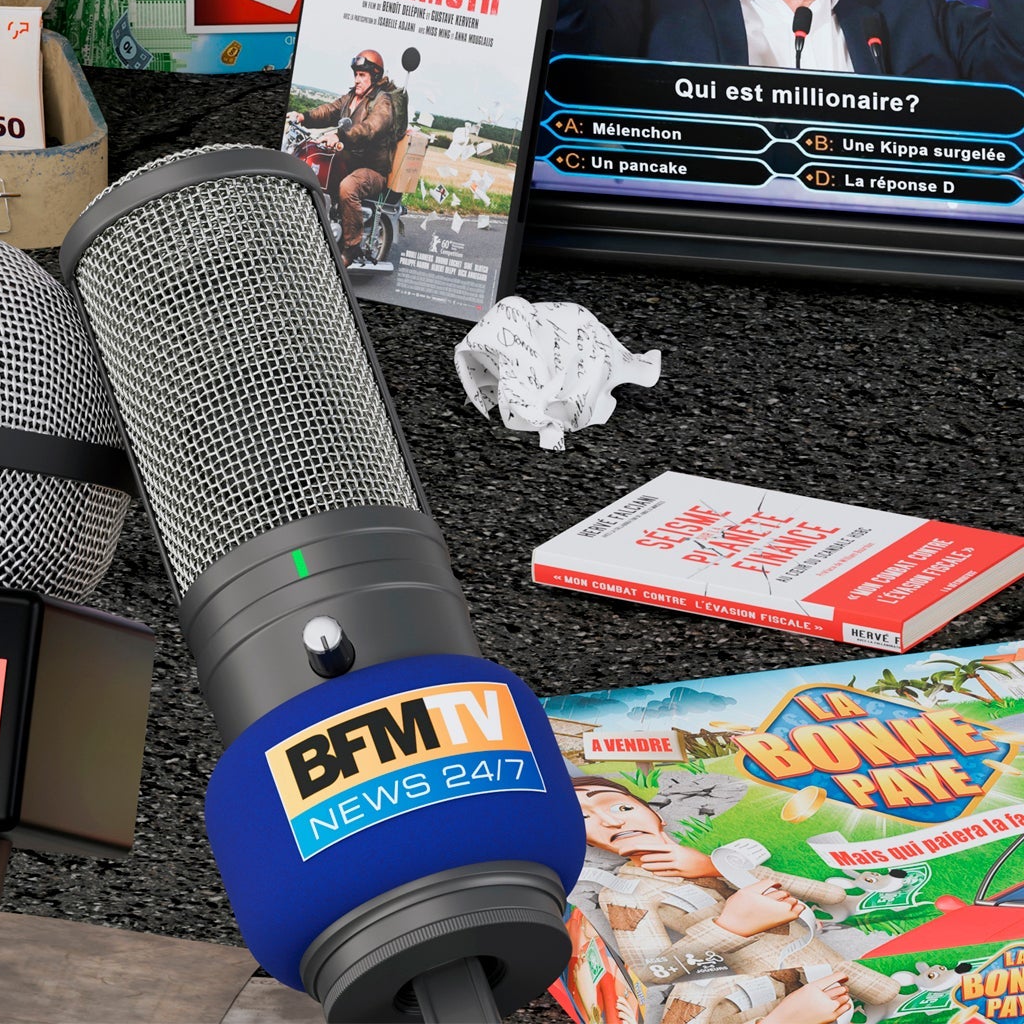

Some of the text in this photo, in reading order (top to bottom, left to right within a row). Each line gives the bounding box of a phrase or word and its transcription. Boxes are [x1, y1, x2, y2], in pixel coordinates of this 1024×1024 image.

[431, 11, 454, 25] GUSTAVE
[455, 15, 479, 29] KERVERN
[675, 78, 920, 113] Qui est millionaire?
[564, 118, 682, 141] A: Mélenchon
[565, 154, 687, 177] C: Un pancake
[815, 136, 1006, 164] B: Une Kippa surgelée
[815, 171, 955, 195] D: La réponse D
[577, 518, 617, 539] HERVÉ
[613, 494, 660, 521] FALCIANI
[635, 505, 732, 550] SÉISME
[732, 521, 841, 574] FINANCE
[871, 560, 918, 584] COMBAT
[908, 537, 954, 561] CONTRE
[564, 576, 811, 631] MON COMBAT CONTRE L'ÉVASION FISCALE
[851, 627, 890, 643] HERVÉ
[793, 690, 869, 722] LA
[286, 690, 504, 801] BFMTV
[592, 736, 673, 753] A VENDRE
[731, 708, 1000, 780] BONNE
[309, 758, 525, 841] NEWS 24/7
[832, 758, 986, 810] PAYE
[829, 818, 1009, 867] Mais qui paiera la
[649, 964, 679, 978] 8+
